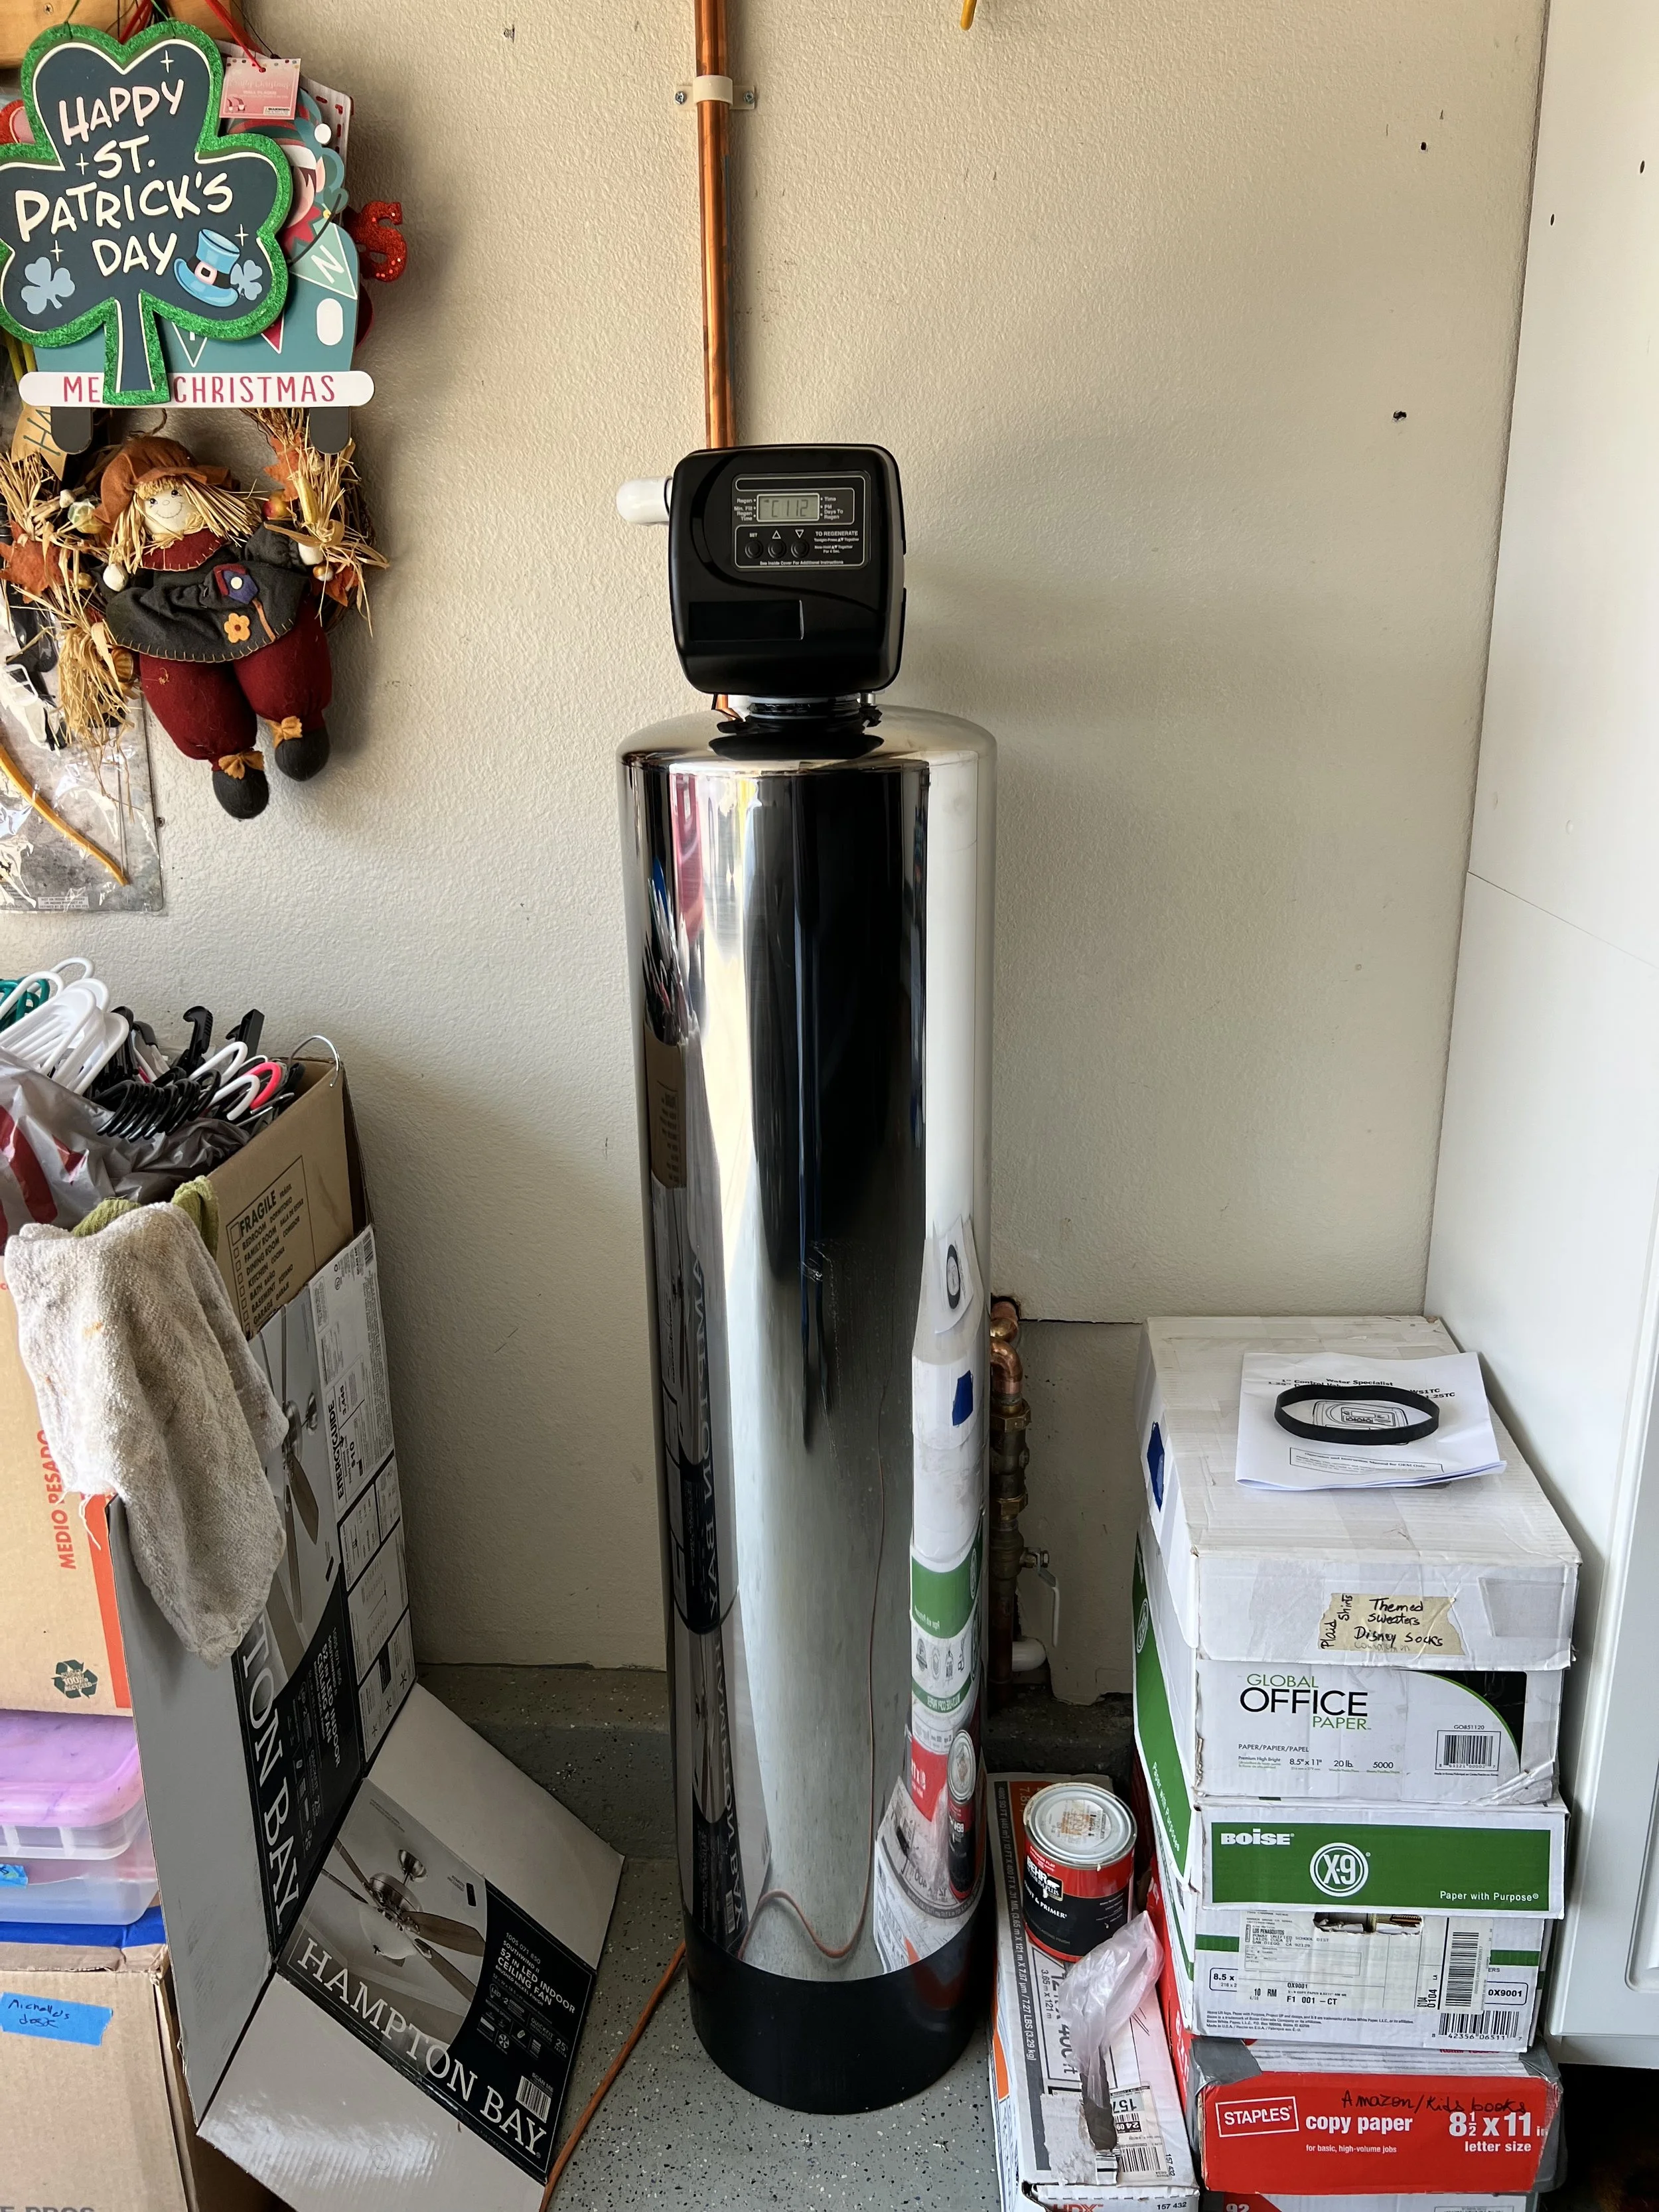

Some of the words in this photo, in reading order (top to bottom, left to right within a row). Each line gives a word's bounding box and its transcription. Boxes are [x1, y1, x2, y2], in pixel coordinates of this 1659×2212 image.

[59, 79, 184, 145] HAPPY
[92, 135, 155, 179] ST.
[15, 172, 234, 242] PATRICK'S
[92, 232, 177, 277] DAY
[173, 375, 335, 404] CHRISTMAS
[240, 1190, 277, 1237] FRAGILE
[242, 1222, 267, 1250] BEDROOM
[244, 1244, 261, 1264] FAMILY
[262, 1226, 277, 1246] ROOM
[246, 1253, 265, 1276] DINING
[265, 1237, 280, 1256] ROOM
[248, 1263, 268, 1289] KITCHEN
[250, 1282, 263, 1301] BATH
[252, 1282, 276, 1313] BASEMENT
[253, 1300, 273, 1325] GARAGE
[51, 1509, 77, 1570] MEDIO
[1338, 1595, 1353, 1621] Shirts
[1369, 1597, 1423, 1612] Themed
[1321, 1619, 1336, 1649] Plaid
[1354, 1626, 1396, 1648] Disney
[62, 1673, 88, 1686] 100%
[65, 1682, 92, 1691] RECYCLED
[318, 1653, 328, 1710] CEILING
[1246, 1673, 1319, 1688] GLOBAL
[323, 1643, 328, 1663] 52
[330, 1708, 340, 1768] INDOOR
[1240, 1686, 1368, 1717] OFFICE
[1313, 1716, 1367, 1730] PAPER
[1238, 1743, 1309, 1752] PAPER/PAPIER/PAPEL
[1152, 1761, 1163, 1789] Paper
[1165, 1809, 1179, 1852] Purpose
[1220, 1828, 1291, 1845] BOISE
[265, 1777, 300, 1926] BAY
[1027, 1856, 1048, 1885] BEHR
[1046, 1885, 1060, 1897] PLUS
[1439, 1890, 1467, 1901] Paper
[1470, 1891, 1490, 1901] with
[1492, 1892, 1532, 1903] Purpose
[1040, 1901, 1066, 1919] PRIMER
[503, 1940, 535, 1969] SOUTHWIND
[506, 1932, 519, 1947] 1005
[520, 1944, 530, 1954] 071
[1015, 1943, 1024, 1953] 121
[498, 1956, 532, 1989] CEILING
[534, 1986, 553, 2006] FAN
[500, 1947, 511, 1960] 52
[512, 1959, 520, 1968] IN
[522, 1964, 538, 1983] LED
[540, 1980, 575, 2014] INDOOR
[1019, 1968, 1027, 1982] 7.87
[1041, 1969, 1050, 1985] 3.65
[1021, 1998, 1031, 2014] 7.27
[1045, 1998, 1054, 2012] 121
[1427, 1989, 1438, 2008] 0104
[1023, 2015, 1033, 2029] LBS
[297, 1937, 477, 2102] HAMPTON
[479, 2085, 547, 2156] BAY
[1025, 2030, 1035, 2047] (3.29
[1027, 2048, 1036, 2061] kg)
[532, 2072, 545, 2086] SCAN
[1224, 2107, 1291, 2126] STAPLES
[1471, 2097, 1527, 2114] books
[1305, 2114, 1351, 2135] copy
[1358, 2115, 1413, 2134] paper
[1483, 2117, 1499, 2136] x
[1507, 2112, 1530, 2136] 11
[1317, 2144, 1337, 2153] basic,
[1338, 2144, 1381, 2154] high-volume
[1382, 2145, 1397, 2154] jobs
[1465, 2141, 1502, 2152] letter
[1505, 2141, 1532, 2152] size
